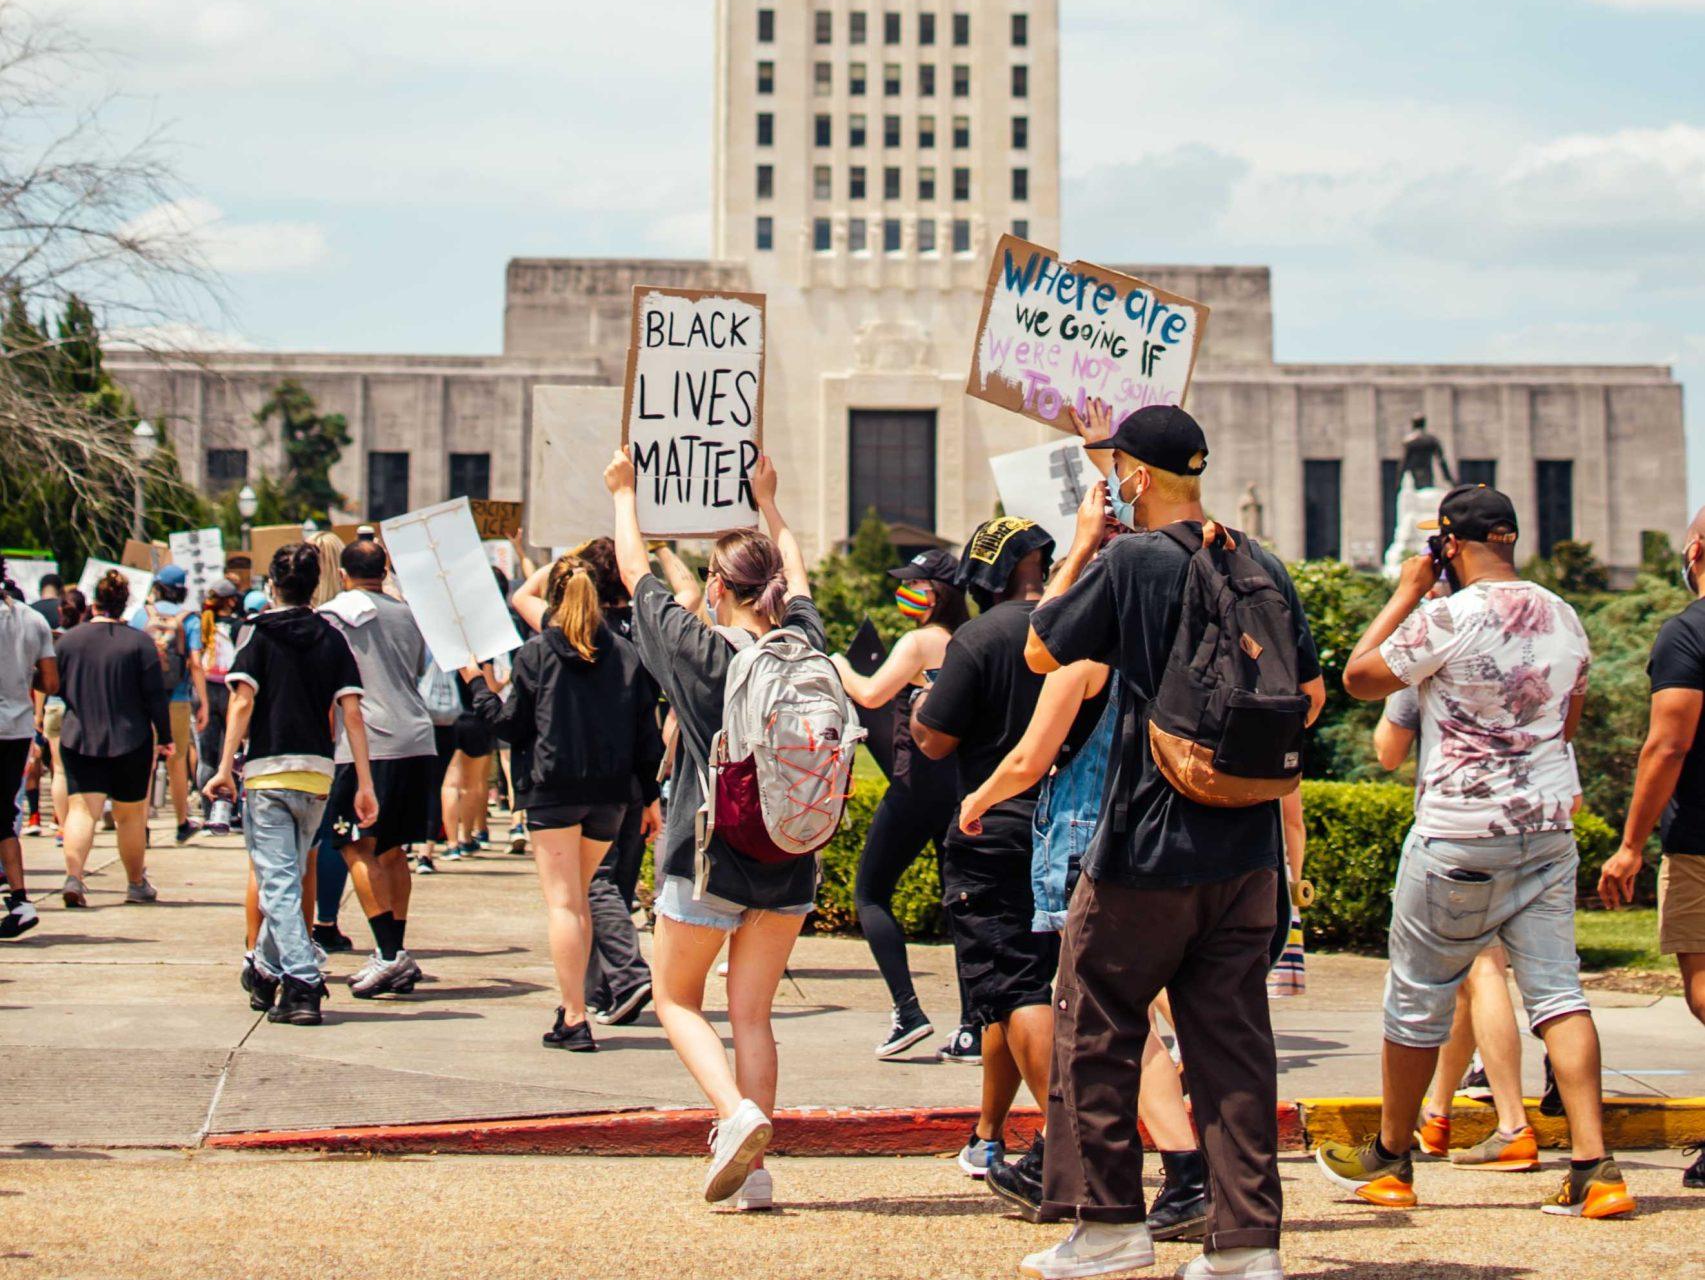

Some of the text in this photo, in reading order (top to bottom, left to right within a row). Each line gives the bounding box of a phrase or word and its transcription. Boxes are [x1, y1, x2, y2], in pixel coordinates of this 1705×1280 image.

[646, 310, 750, 349] BLACK
[1124, 288, 1188, 345] are
[1072, 349, 1121, 391] NOT
[1141, 340, 1167, 378] IF
[638, 369, 757, 428] LIVES
[1022, 369, 1062, 420] TO
[633, 435, 760, 512] MATTER
